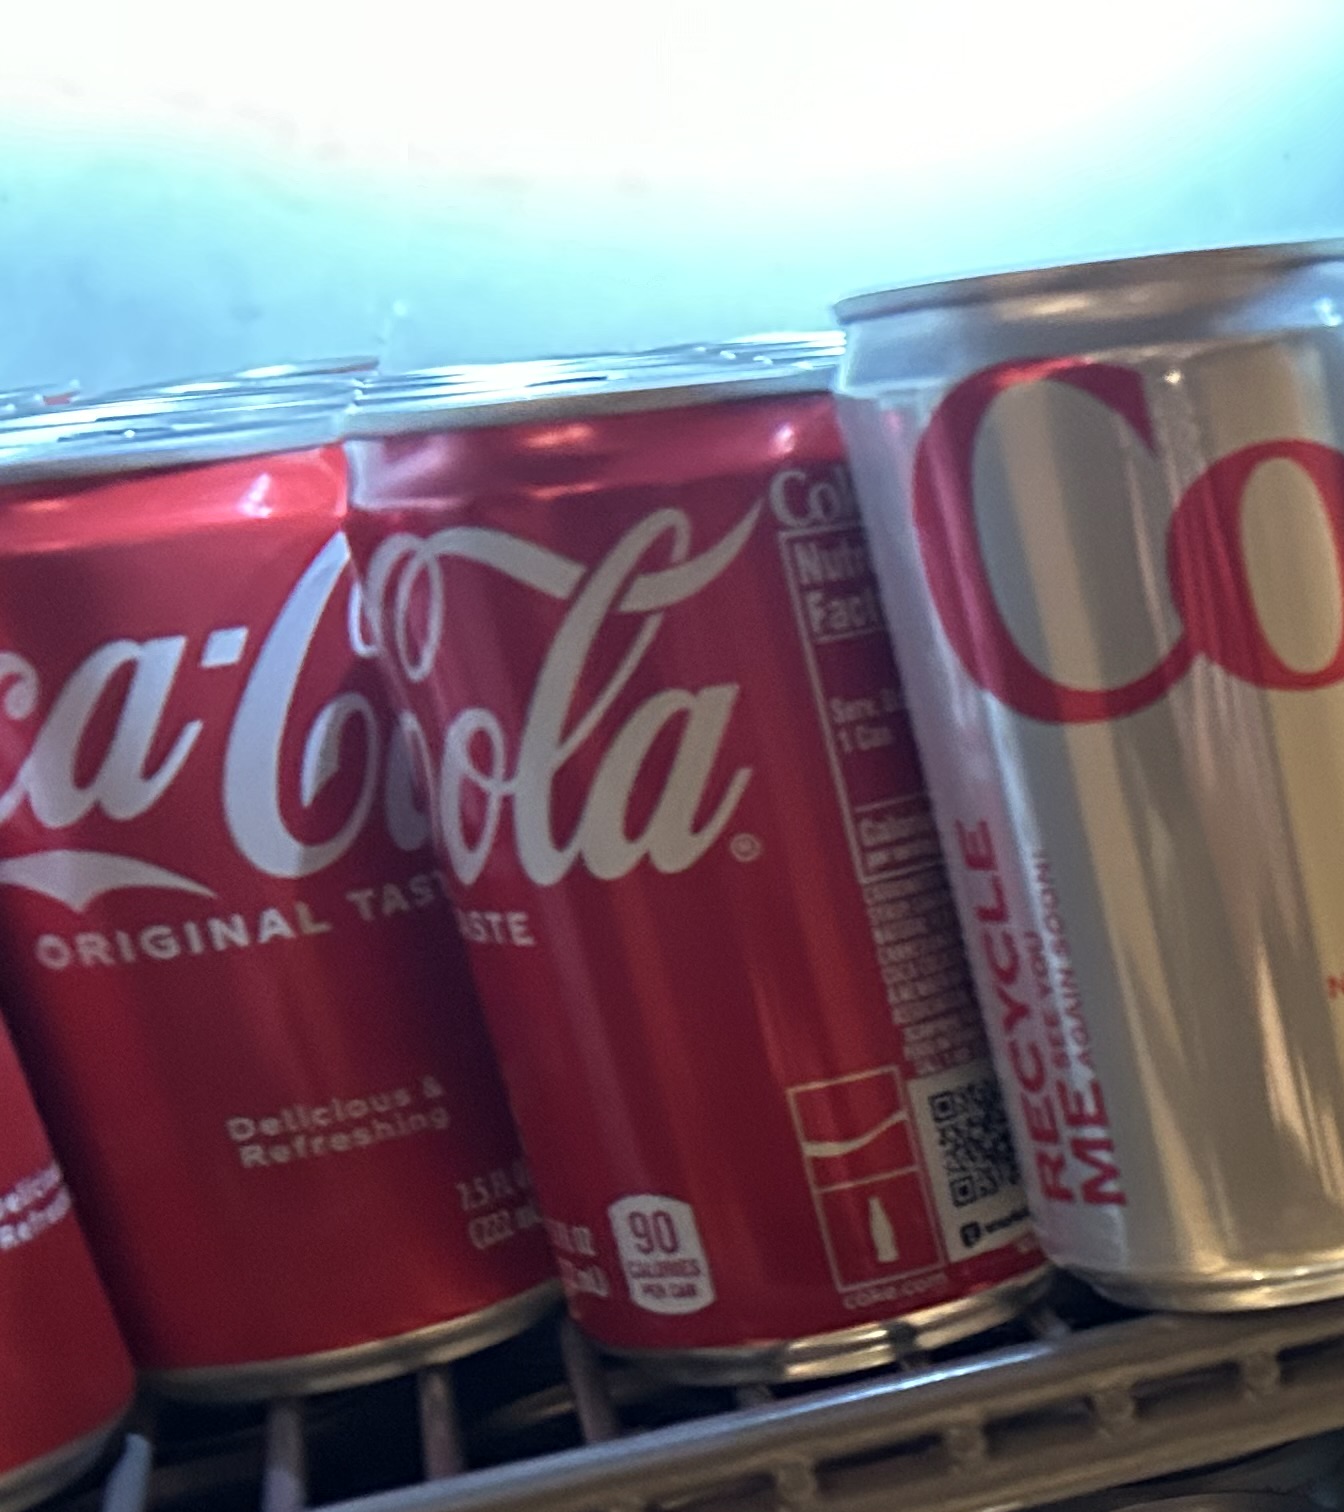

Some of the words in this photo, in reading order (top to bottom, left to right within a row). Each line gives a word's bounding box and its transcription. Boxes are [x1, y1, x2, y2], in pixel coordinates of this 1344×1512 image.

[34, 903, 332, 971] ORIGINAL
[344, 870, 447, 922] TAS
[953, 817, 1074, 1204] RECYCLE
[225, 1084, 413, 1143] Delicious
[421, 1074, 446, 1100] &
[239, 1105, 452, 1169] Refreshing
[1066, 1079, 1127, 1207] ME
[627, 1209, 679, 1256] 90
